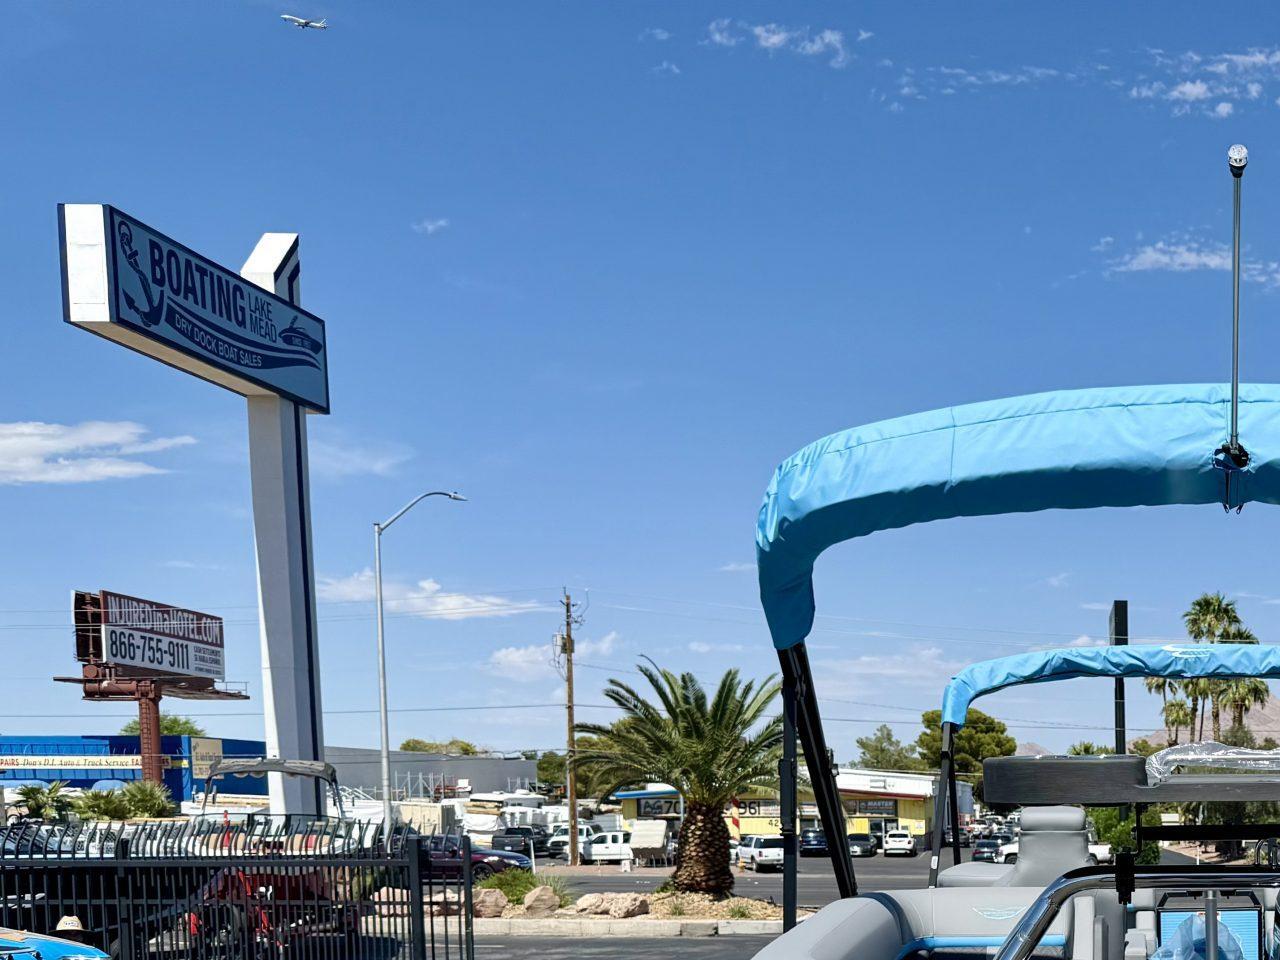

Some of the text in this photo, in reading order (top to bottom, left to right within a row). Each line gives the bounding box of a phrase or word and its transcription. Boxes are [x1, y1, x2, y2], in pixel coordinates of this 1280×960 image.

[150, 238, 247, 329] BOATING
[248, 292, 272, 322] LAKE
[175, 315, 262, 367] DRY DOCK BOAT SALES
[249, 312, 278, 343] MEAD
[109, 629, 190, 670] 866-755-9111
[105, 758, 129, 766] Service
